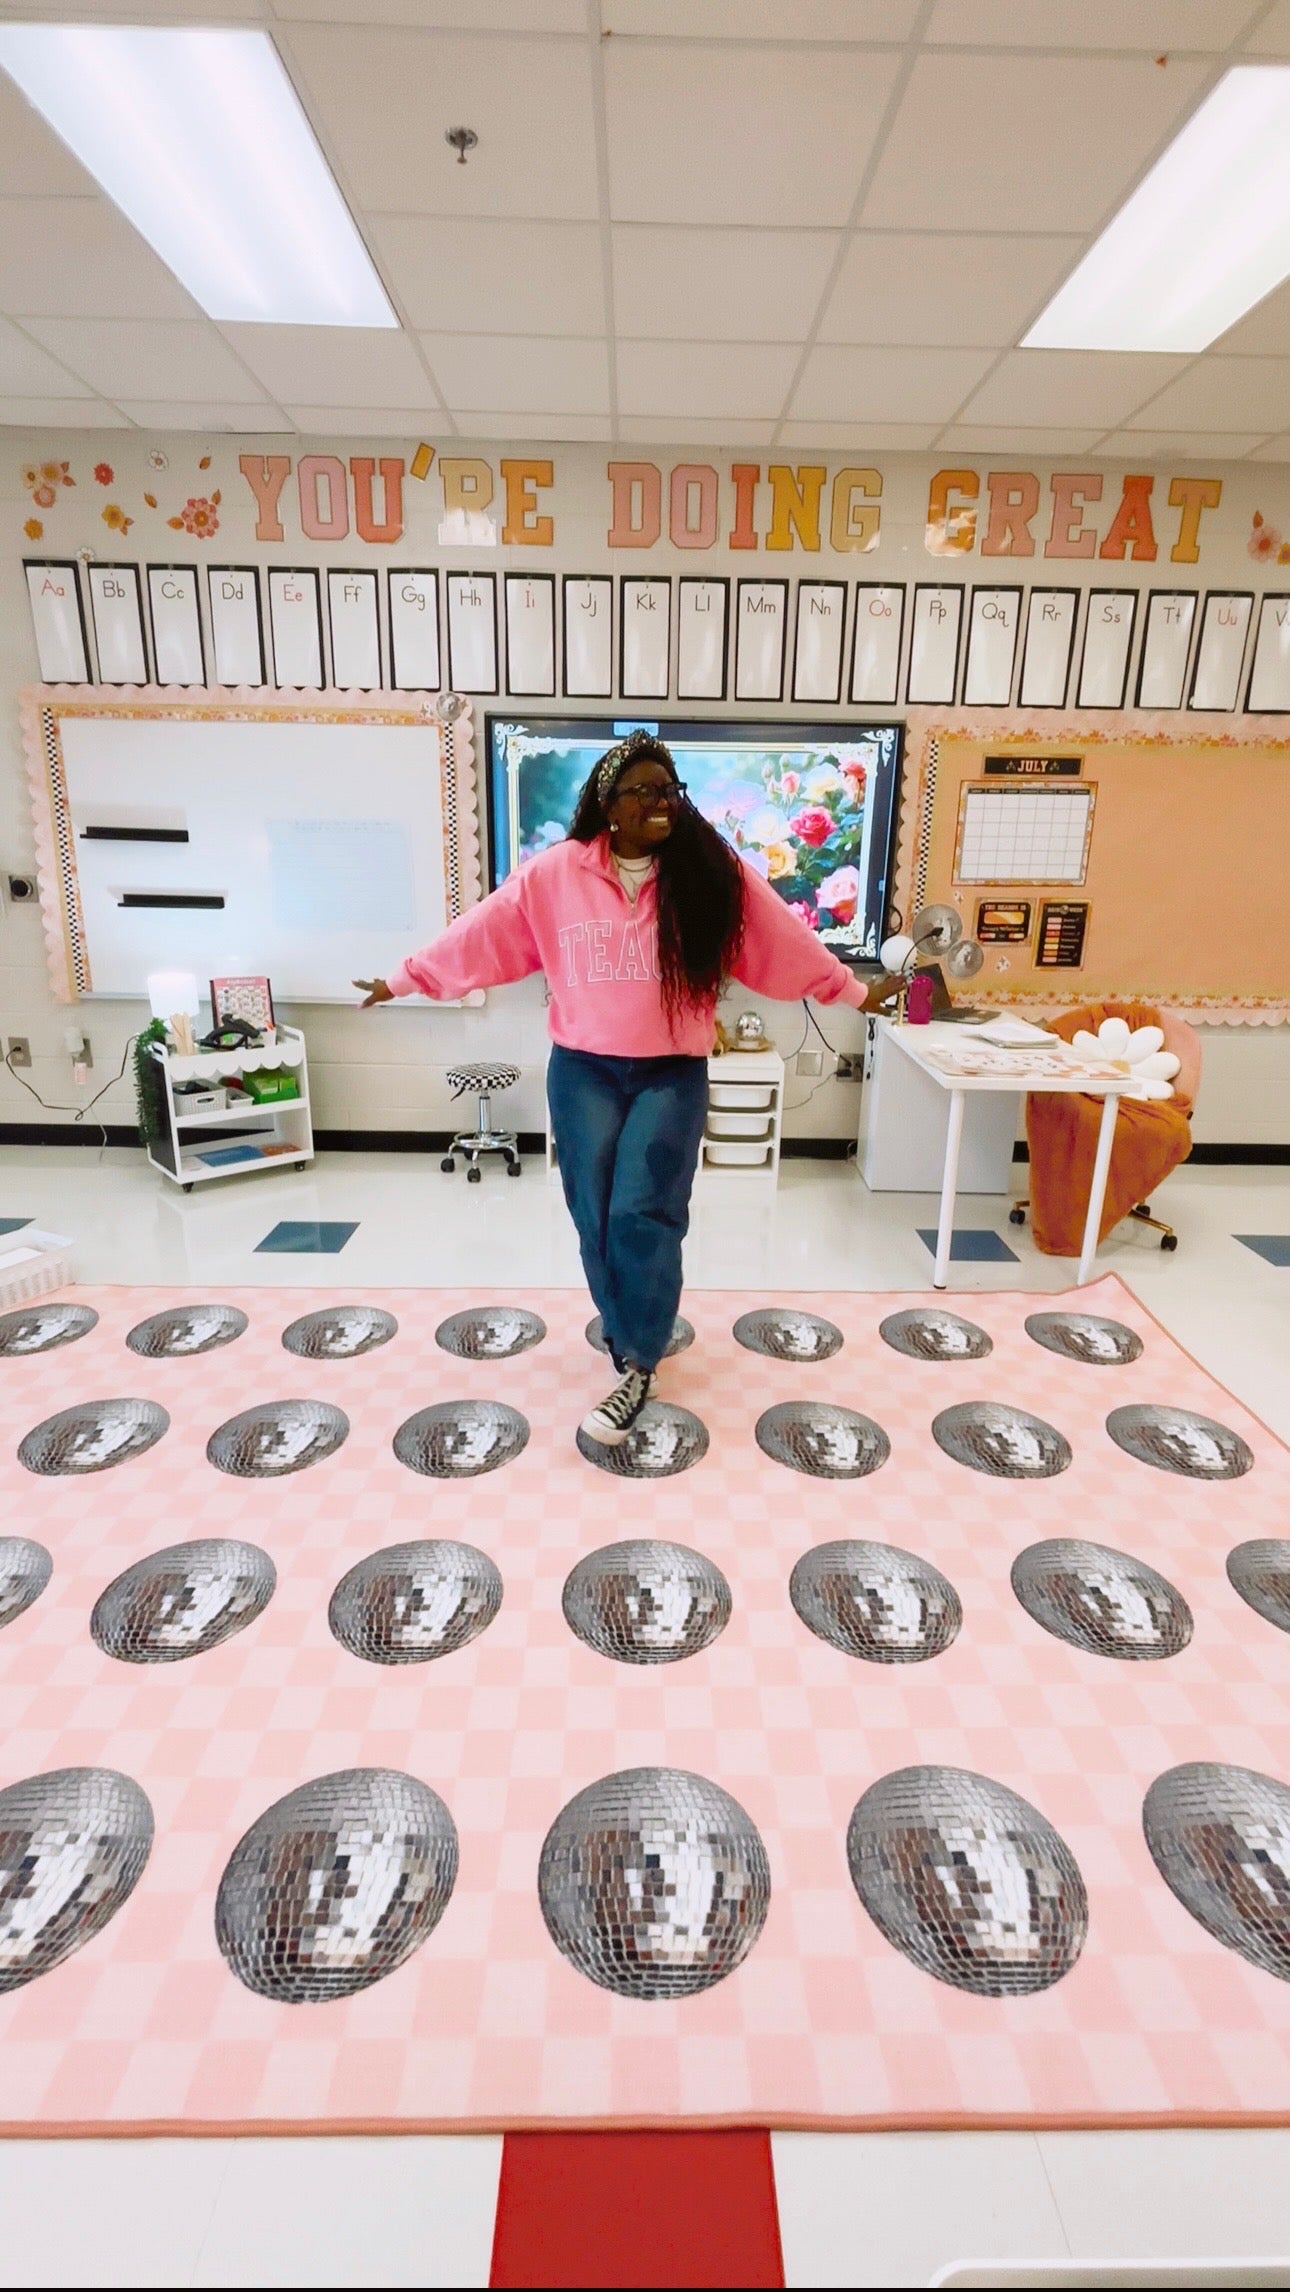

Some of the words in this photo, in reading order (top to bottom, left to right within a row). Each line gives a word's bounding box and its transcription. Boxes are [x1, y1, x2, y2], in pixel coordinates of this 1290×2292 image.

[239, 442, 554, 546] YOU'RE
[608, 463, 883, 553] DOING
[924, 469, 1222, 563] GREAT
[41, 578, 65, 597] Aa
[102, 579, 126, 599] Bb
[160, 581, 185, 600] Cc
[221, 581, 244, 601] Dd
[283, 583, 303, 602] Ee
[343, 584, 363, 603] Ff
[400, 585, 426, 612] Gg
[459, 588, 482, 607] Hh
[580, 591, 597, 618] Jj
[636, 592, 657, 611] Kk
[746, 595, 777, 614] Mm
[810, 597, 832, 616] Nn
[868, 599, 893, 617] Oo
[928, 599, 948, 626] Pp
[981, 602, 1010, 629] Qq
[1041, 603, 1062, 622] Rr
[1101, 605, 1121, 624] Ss
[1162, 606, 1181, 625] Tt
[1217, 608, 1238, 626] Uu
[1017, 760, 1048, 773] JULY
